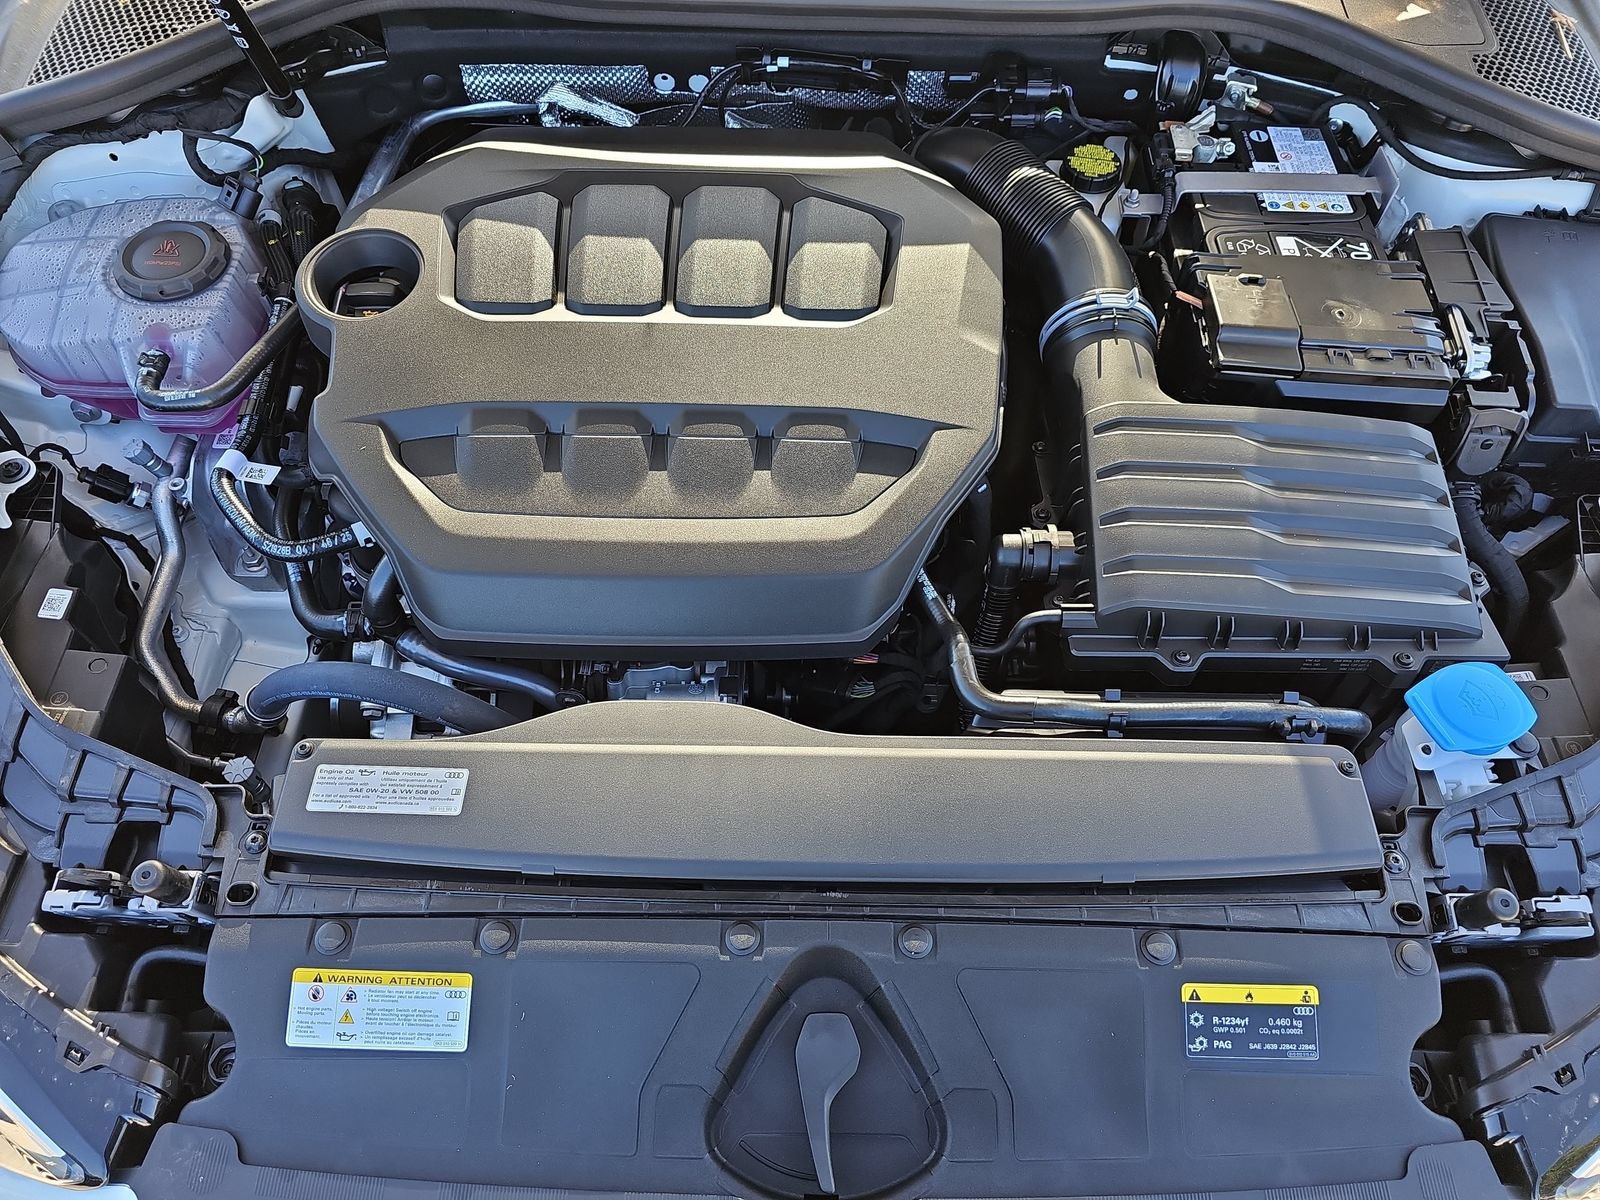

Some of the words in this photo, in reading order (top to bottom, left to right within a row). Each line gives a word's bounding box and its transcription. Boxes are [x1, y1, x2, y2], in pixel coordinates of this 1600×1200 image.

[1346, 242, 1372, 260] 70
[342, 532, 353, 543] 25
[328, 975, 383, 984] WARNING
[389, 977, 452, 986] ATTENTION
[1212, 1016, 1249, 1027] R-1234yf
[1268, 1018, 1291, 1026] 0.460
[1293, 1018, 1302, 1027] kg
[1213, 1040, 1232, 1049] PAG
